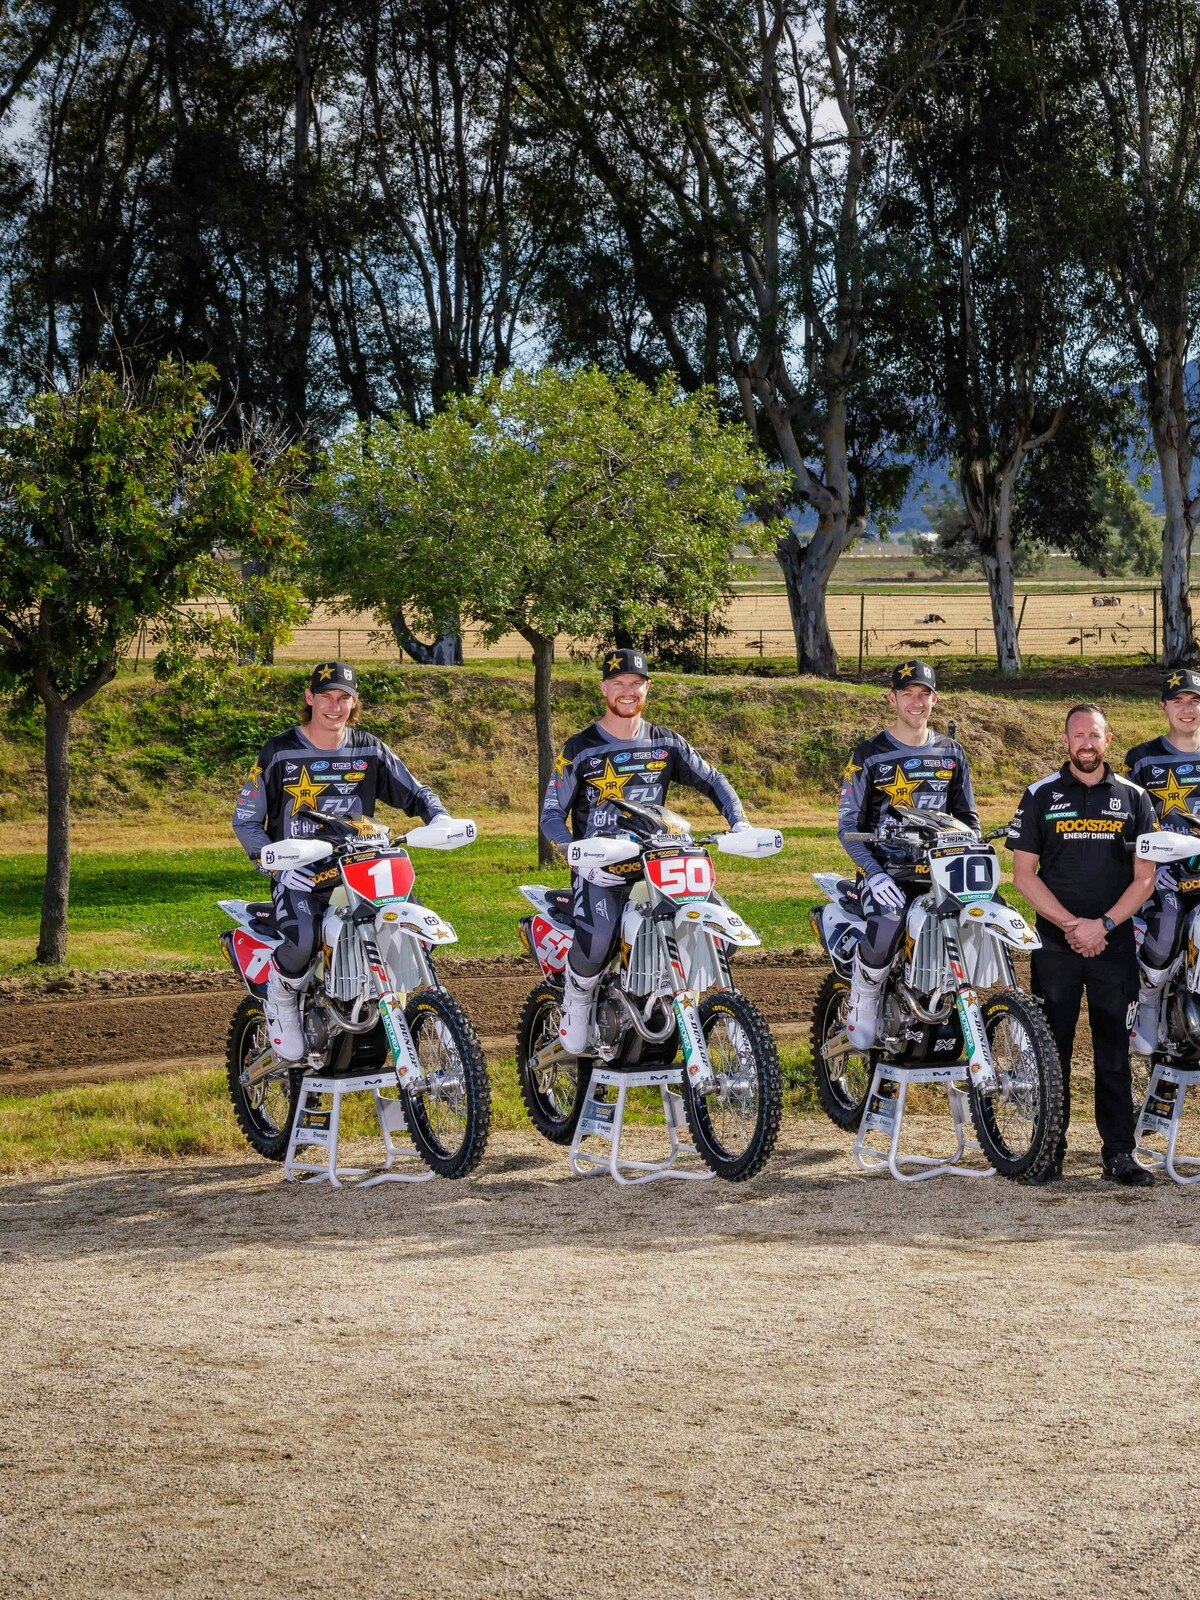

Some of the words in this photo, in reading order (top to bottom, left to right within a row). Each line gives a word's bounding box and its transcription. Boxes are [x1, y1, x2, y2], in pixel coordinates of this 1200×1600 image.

[321, 797, 357, 815] FLY
[628, 787, 662, 801] FLY
[918, 795, 947, 809] FLY
[1056, 819, 1123, 833] ROCKSTAR
[309, 867, 340, 884] ROCKS
[368, 859, 395, 898] 1
[609, 862, 642, 875] ROCKS
[660, 858, 711, 895] 50
[945, 856, 993, 893] 10
[245, 948, 273, 979] 1
[383, 1013, 399, 1053] MOTOREX
[399, 1022, 419, 1068] DUNLOP
[676, 1013, 692, 1050] MOTOREX
[691, 1021, 709, 1068] DUNLOP
[959, 1011, 975, 1049] MOTOREX
[974, 1021, 991, 1066] DUNLOP
